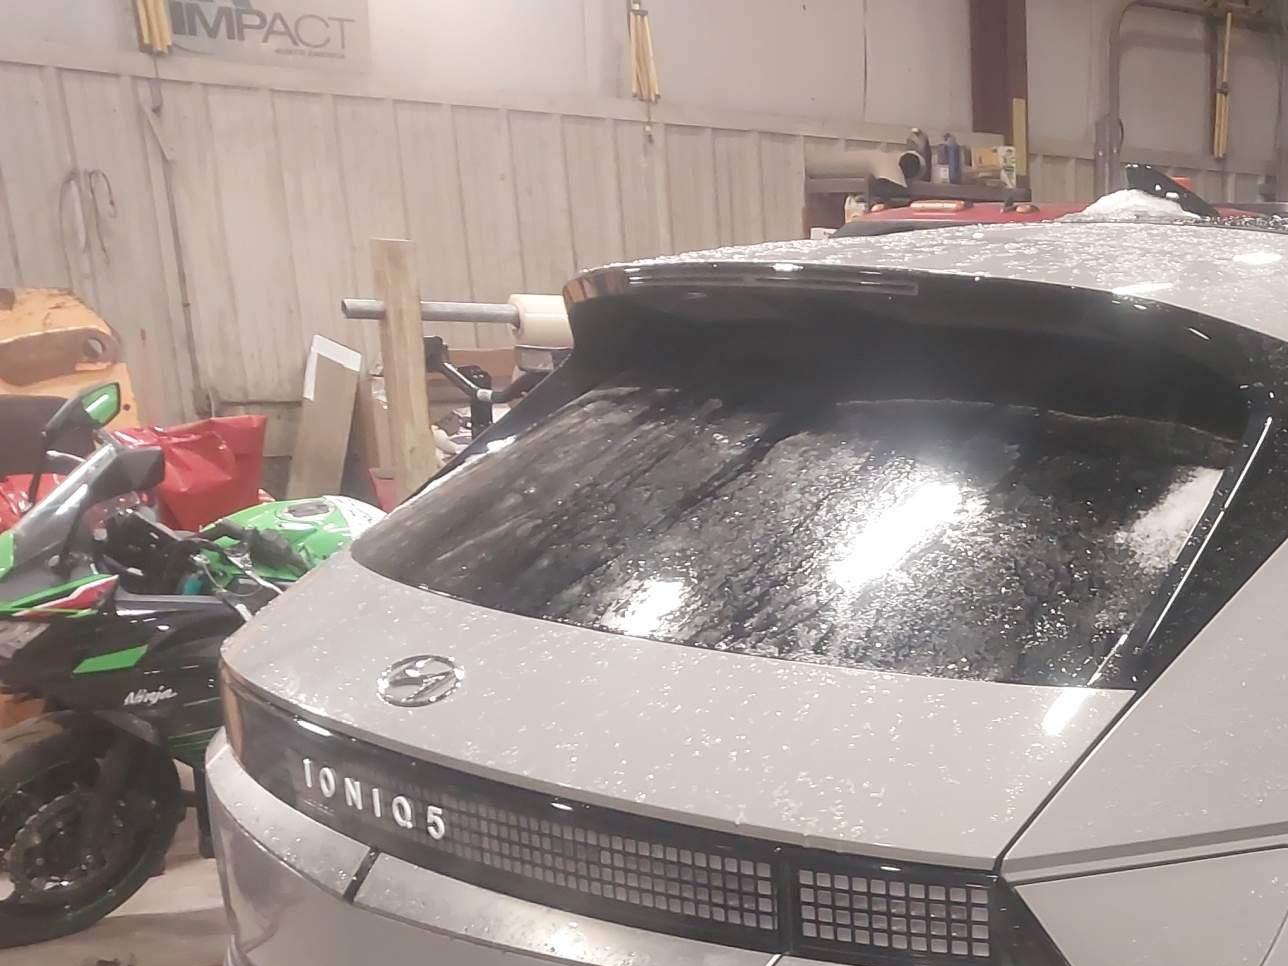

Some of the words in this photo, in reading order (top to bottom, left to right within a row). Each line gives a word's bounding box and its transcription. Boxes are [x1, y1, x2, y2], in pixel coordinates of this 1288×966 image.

[168, 1, 356, 49] IMPACT
[123, 685, 178, 706] Ninja
[303, 758, 413, 829] IONIQ
[426, 805, 446, 840] 5
